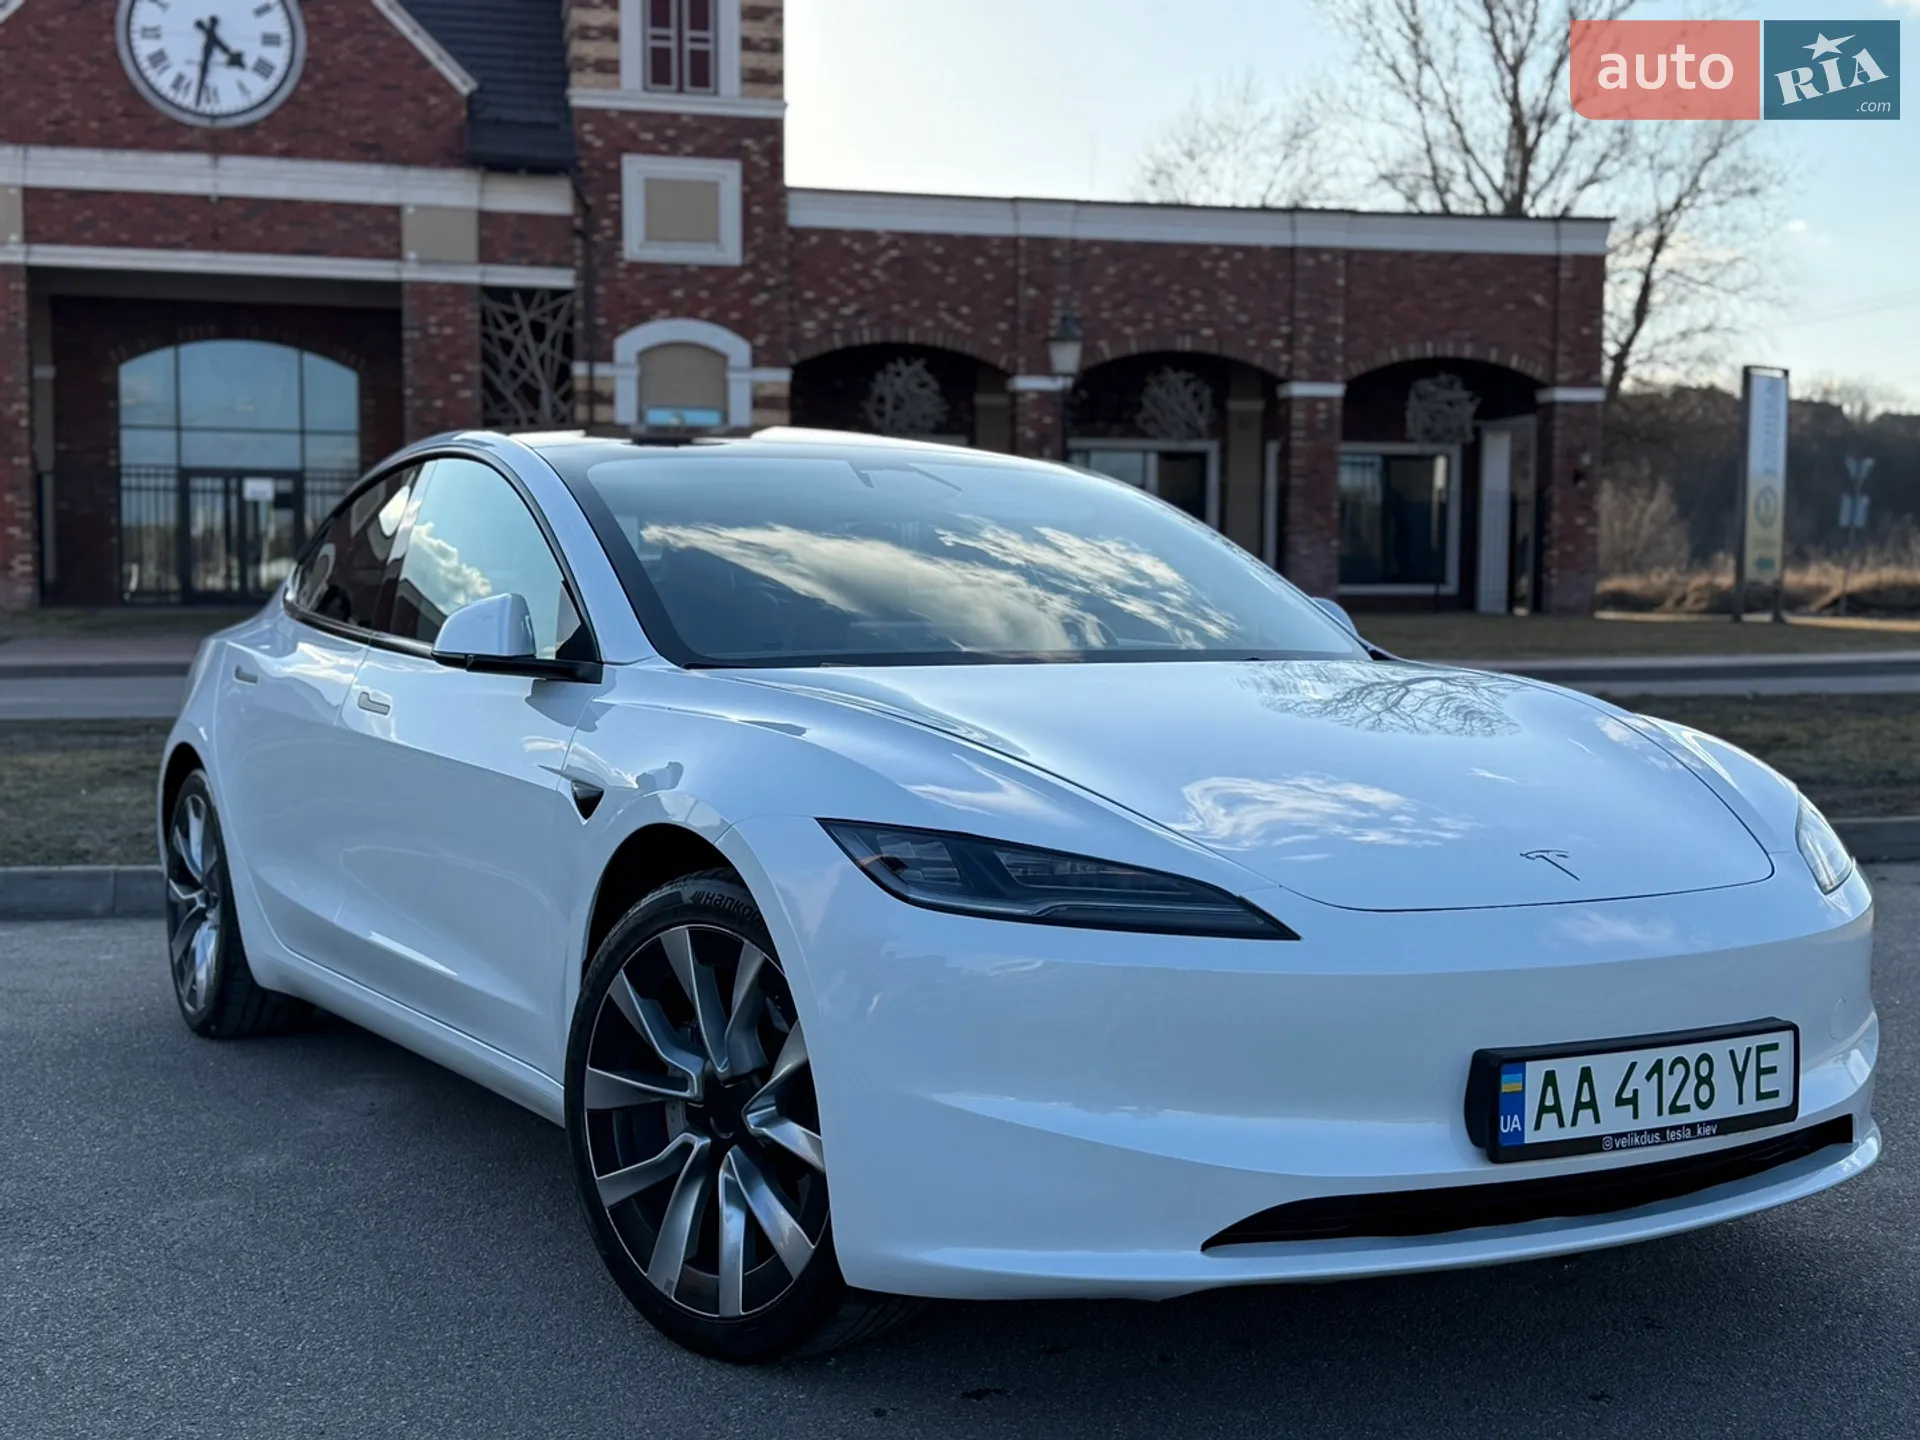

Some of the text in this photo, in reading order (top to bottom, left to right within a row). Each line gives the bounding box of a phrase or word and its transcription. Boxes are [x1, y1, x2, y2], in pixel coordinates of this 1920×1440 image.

[702, 890, 763, 924] Hankoo
[1533, 1042, 1780, 1131] AA 4128 YE
[1500, 1114, 1522, 1134] UA
